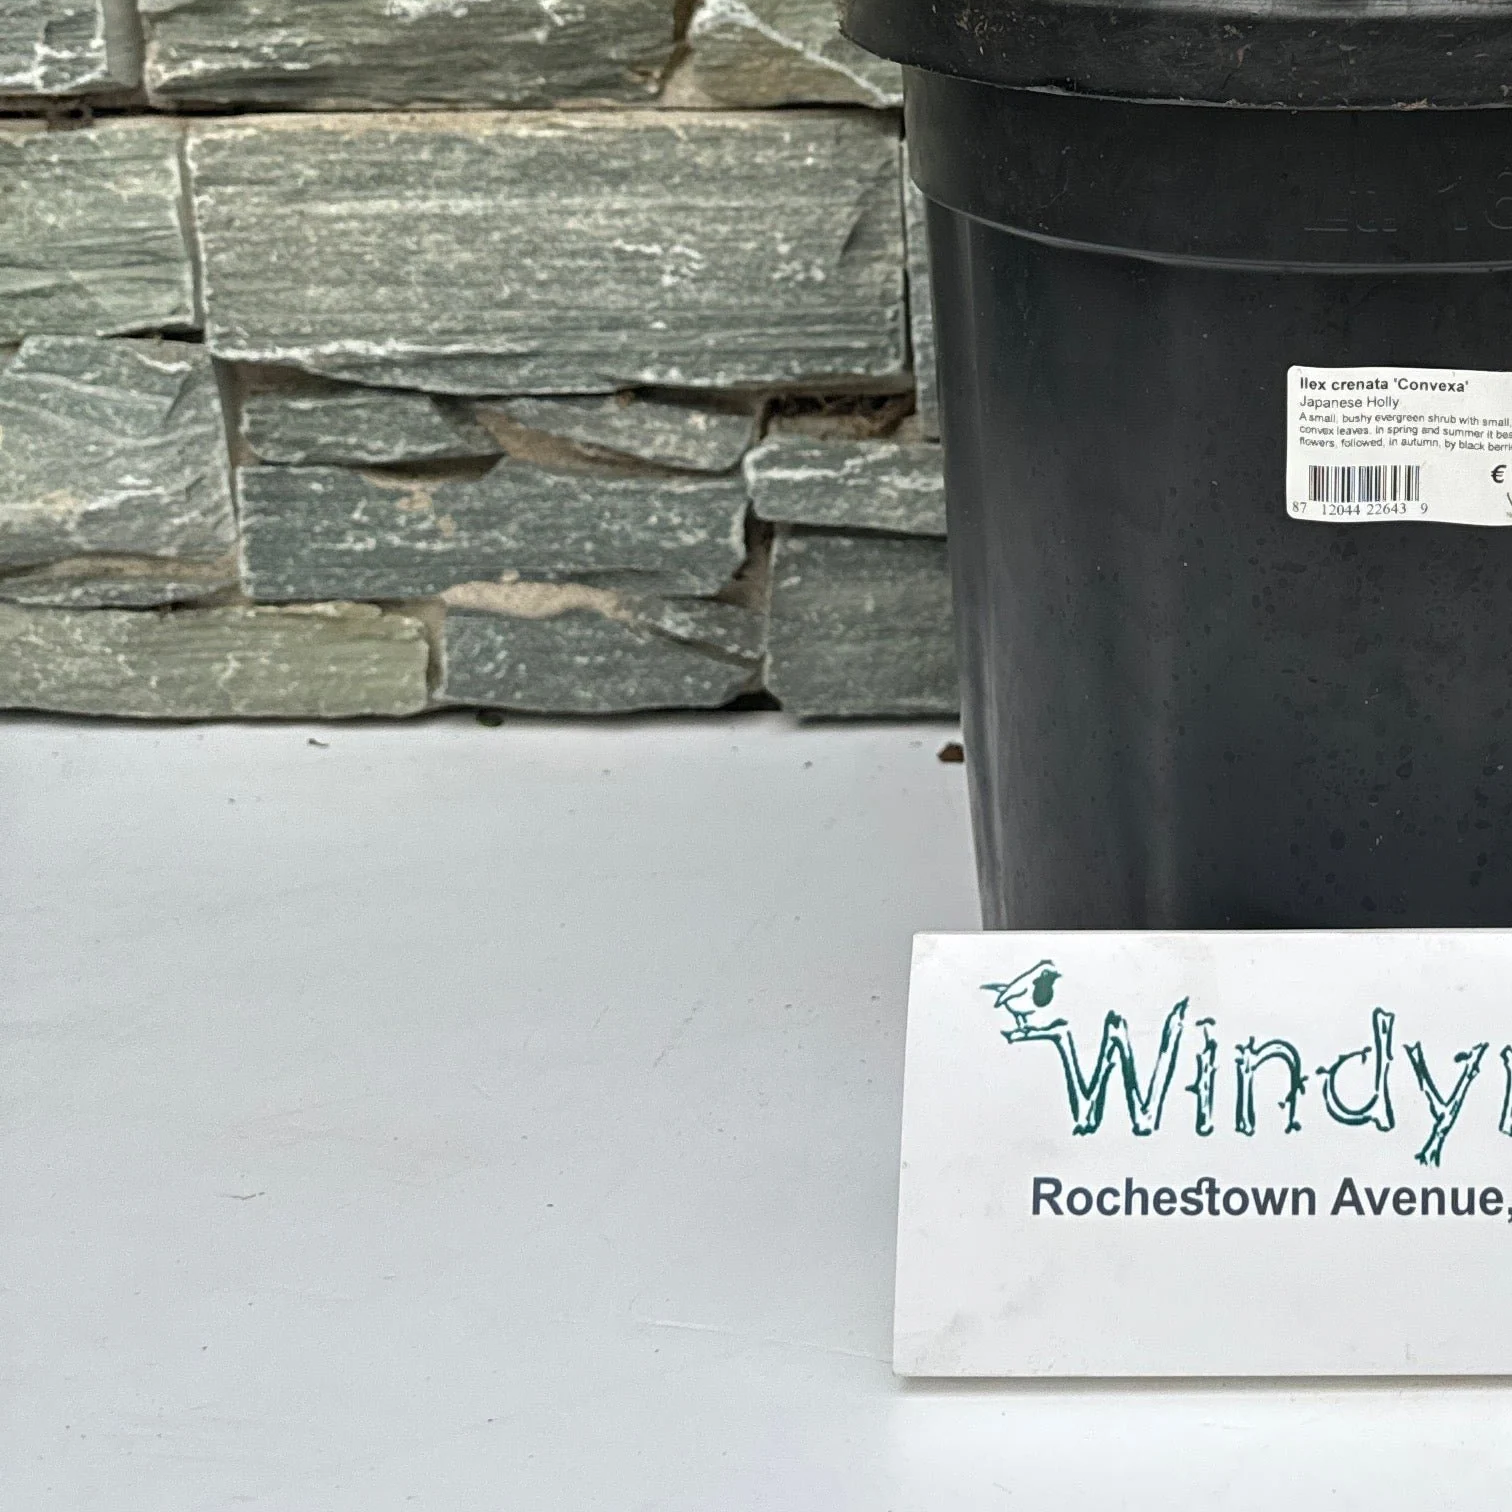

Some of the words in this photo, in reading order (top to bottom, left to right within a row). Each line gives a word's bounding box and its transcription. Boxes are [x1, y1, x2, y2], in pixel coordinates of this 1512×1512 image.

[1300, 377, 1327, 391] Ilex
[1331, 377, 1389, 390] crenata
[1393, 377, 1469, 393] 'Convexa'
[1300, 395, 1363, 410] Japanese
[1366, 396, 1400, 410] Holly
[1299, 411, 1307, 422] A
[1342, 413, 1372, 425] bushy
[1375, 413, 1425, 424] evergreen
[1428, 413, 1457, 424] shrub
[1459, 415, 1480, 426] with
[1299, 424, 1335, 436] convex
[1387, 424, 1419, 436] spring
[1421, 426, 1440, 435] and
[1442, 428, 1485, 439] summer
[1487, 429, 1494, 440] it
[1388, 437, 1398, 447] in
[1444, 439, 1457, 452] by
[1458, 440, 1486, 451] black
[1490, 464, 1507, 484] €
[1292, 501, 1307, 513] 87
[1321, 503, 1361, 516] 12044
[1366, 502, 1407, 516] 22643
[1420, 503, 1429, 514] 9
[1031, 1177, 1317, 1217] Rochestown
